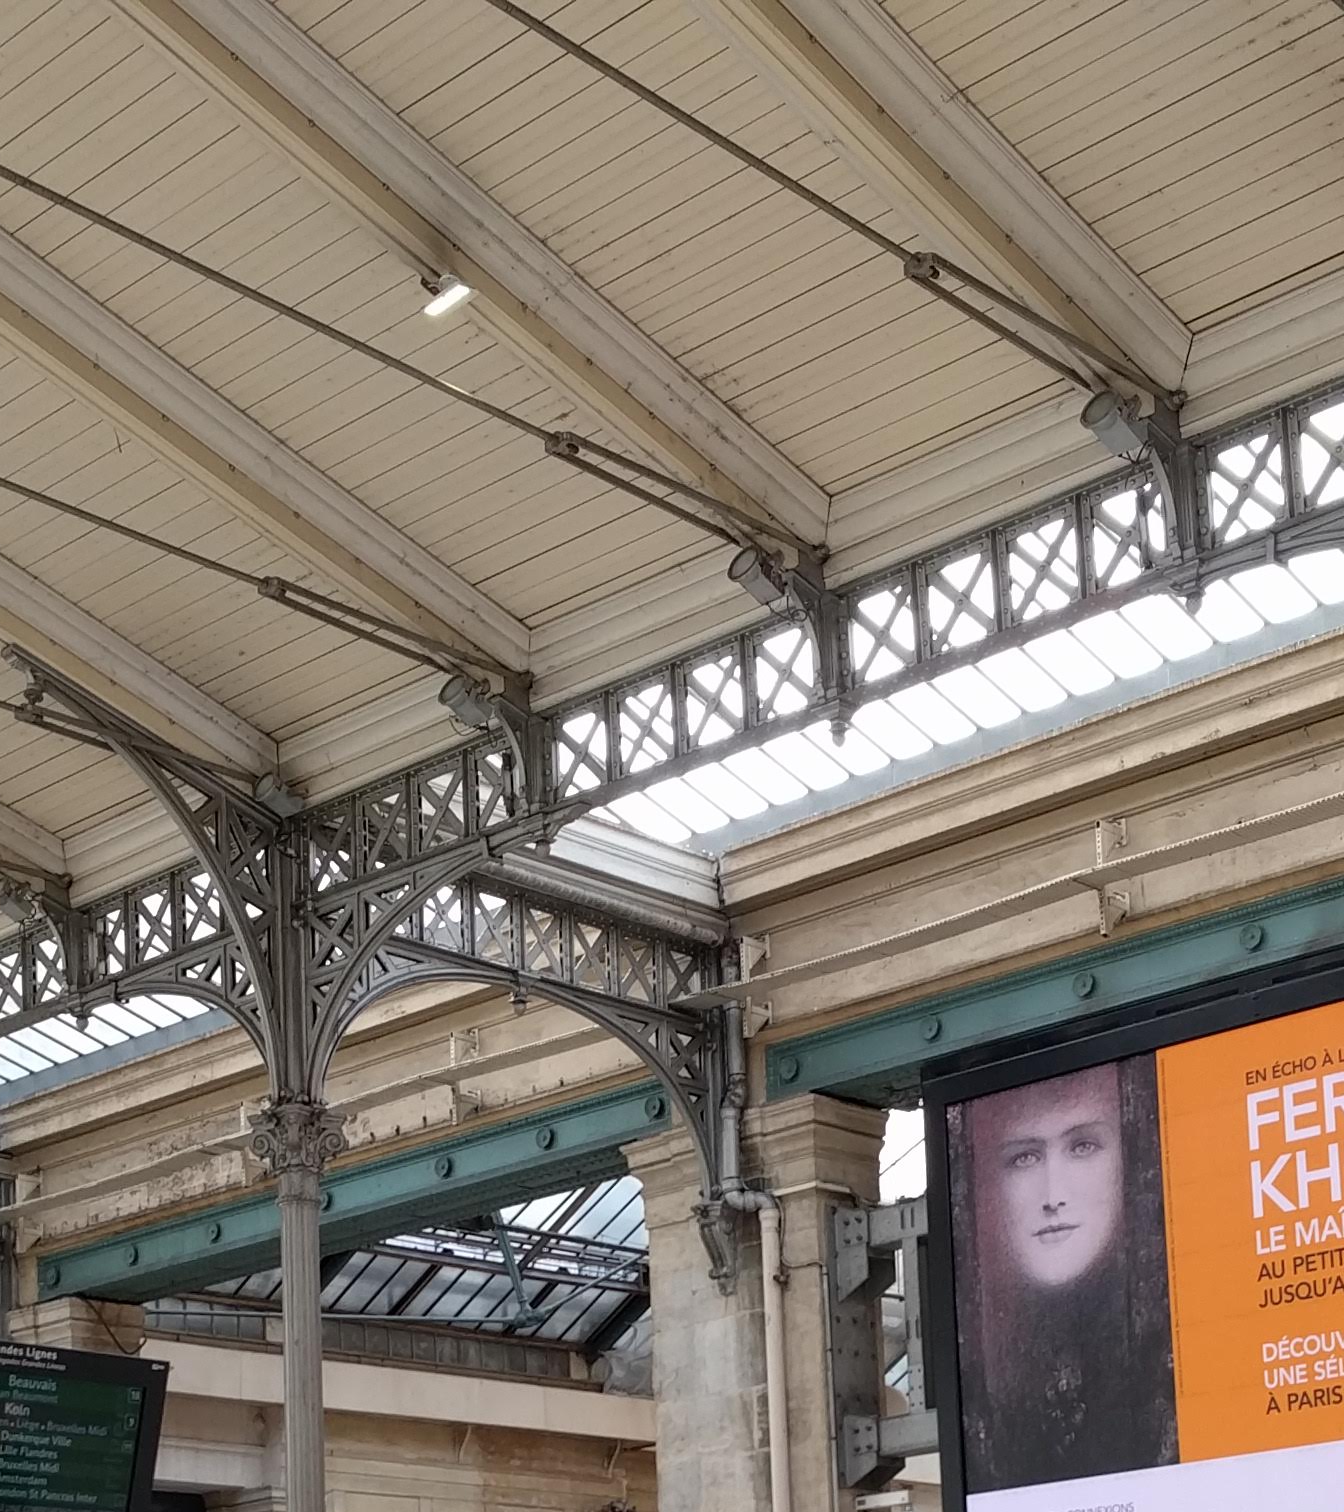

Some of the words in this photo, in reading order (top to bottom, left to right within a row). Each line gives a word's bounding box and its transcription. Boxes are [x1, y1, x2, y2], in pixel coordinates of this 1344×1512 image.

[1245, 1070, 1267, 1085] EN
[1271, 1055, 1317, 1079] ÉCHO
[1321, 1049, 1334, 1068] À
[1255, 1225, 1286, 1255] LE
[1257, 1259, 1285, 1282] AU
[26, 1347, 58, 1361] Lignes
[9, 1374, 57, 1392] Beauvais
[1264, 1363, 1308, 1390] UNE
[1266, 1392, 1281, 1416] À
[1287, 1385, 1344, 1411] PARIS
